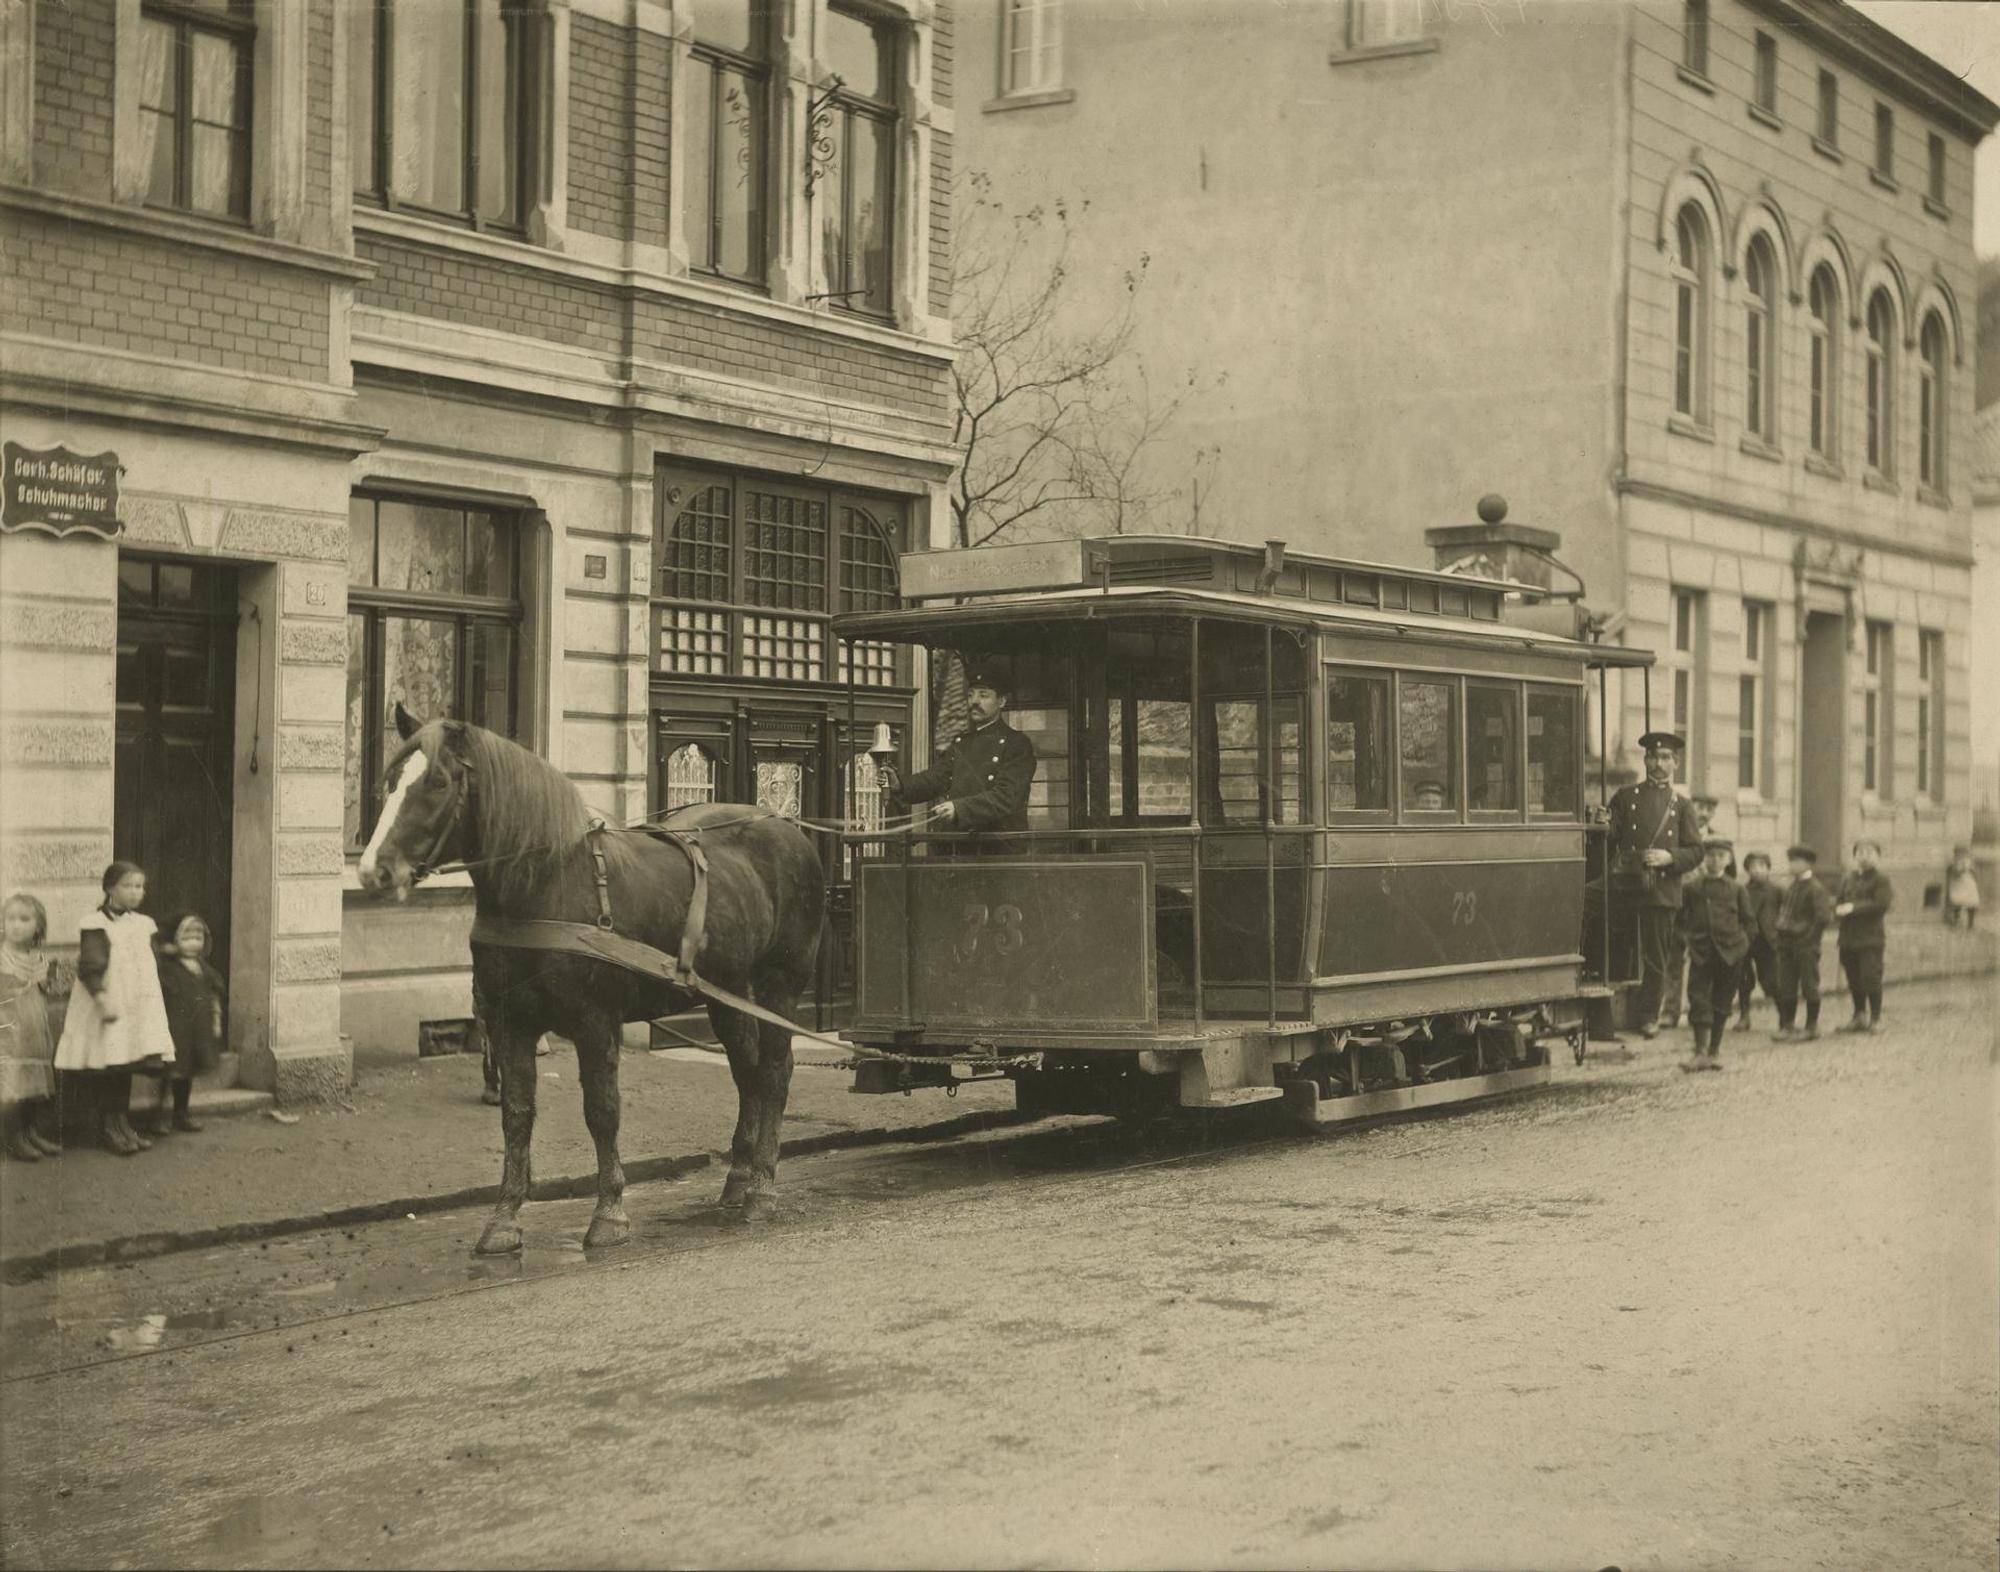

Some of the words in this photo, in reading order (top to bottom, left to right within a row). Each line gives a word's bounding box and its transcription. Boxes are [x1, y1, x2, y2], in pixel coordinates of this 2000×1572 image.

[18, 484, 108, 511] Schuhmacher
[1452, 890, 1476, 927] 73
[958, 903, 1023, 957] 73
